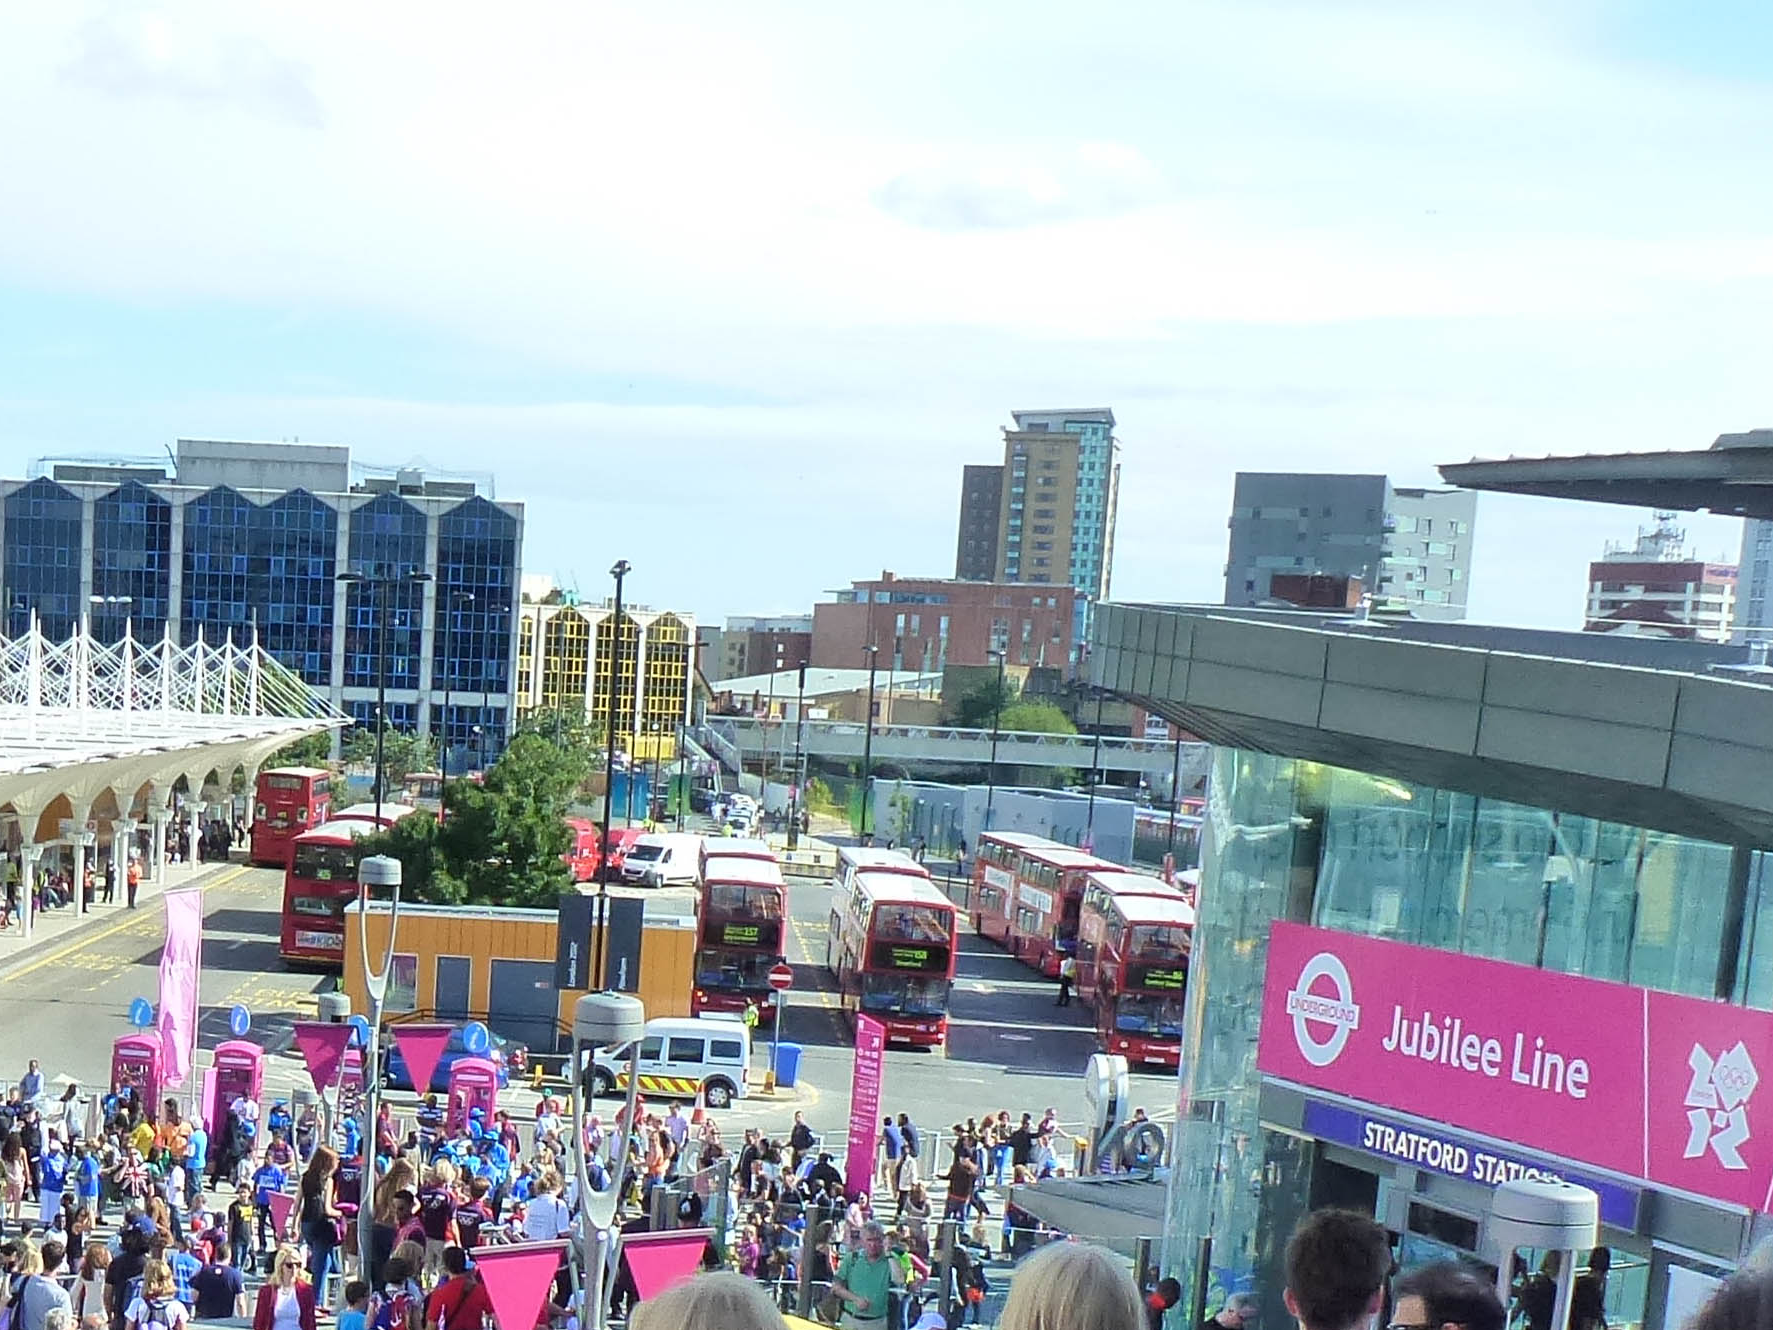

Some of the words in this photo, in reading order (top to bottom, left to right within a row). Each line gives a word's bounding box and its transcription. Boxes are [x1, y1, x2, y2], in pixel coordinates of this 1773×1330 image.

[1290, 996, 1355, 1022] UNDERGROUND
[1382, 1005, 1502, 1077] Jubilee
[1511, 1032, 1589, 1098] Line
[1364, 1121, 1468, 1173] STRATFORD
